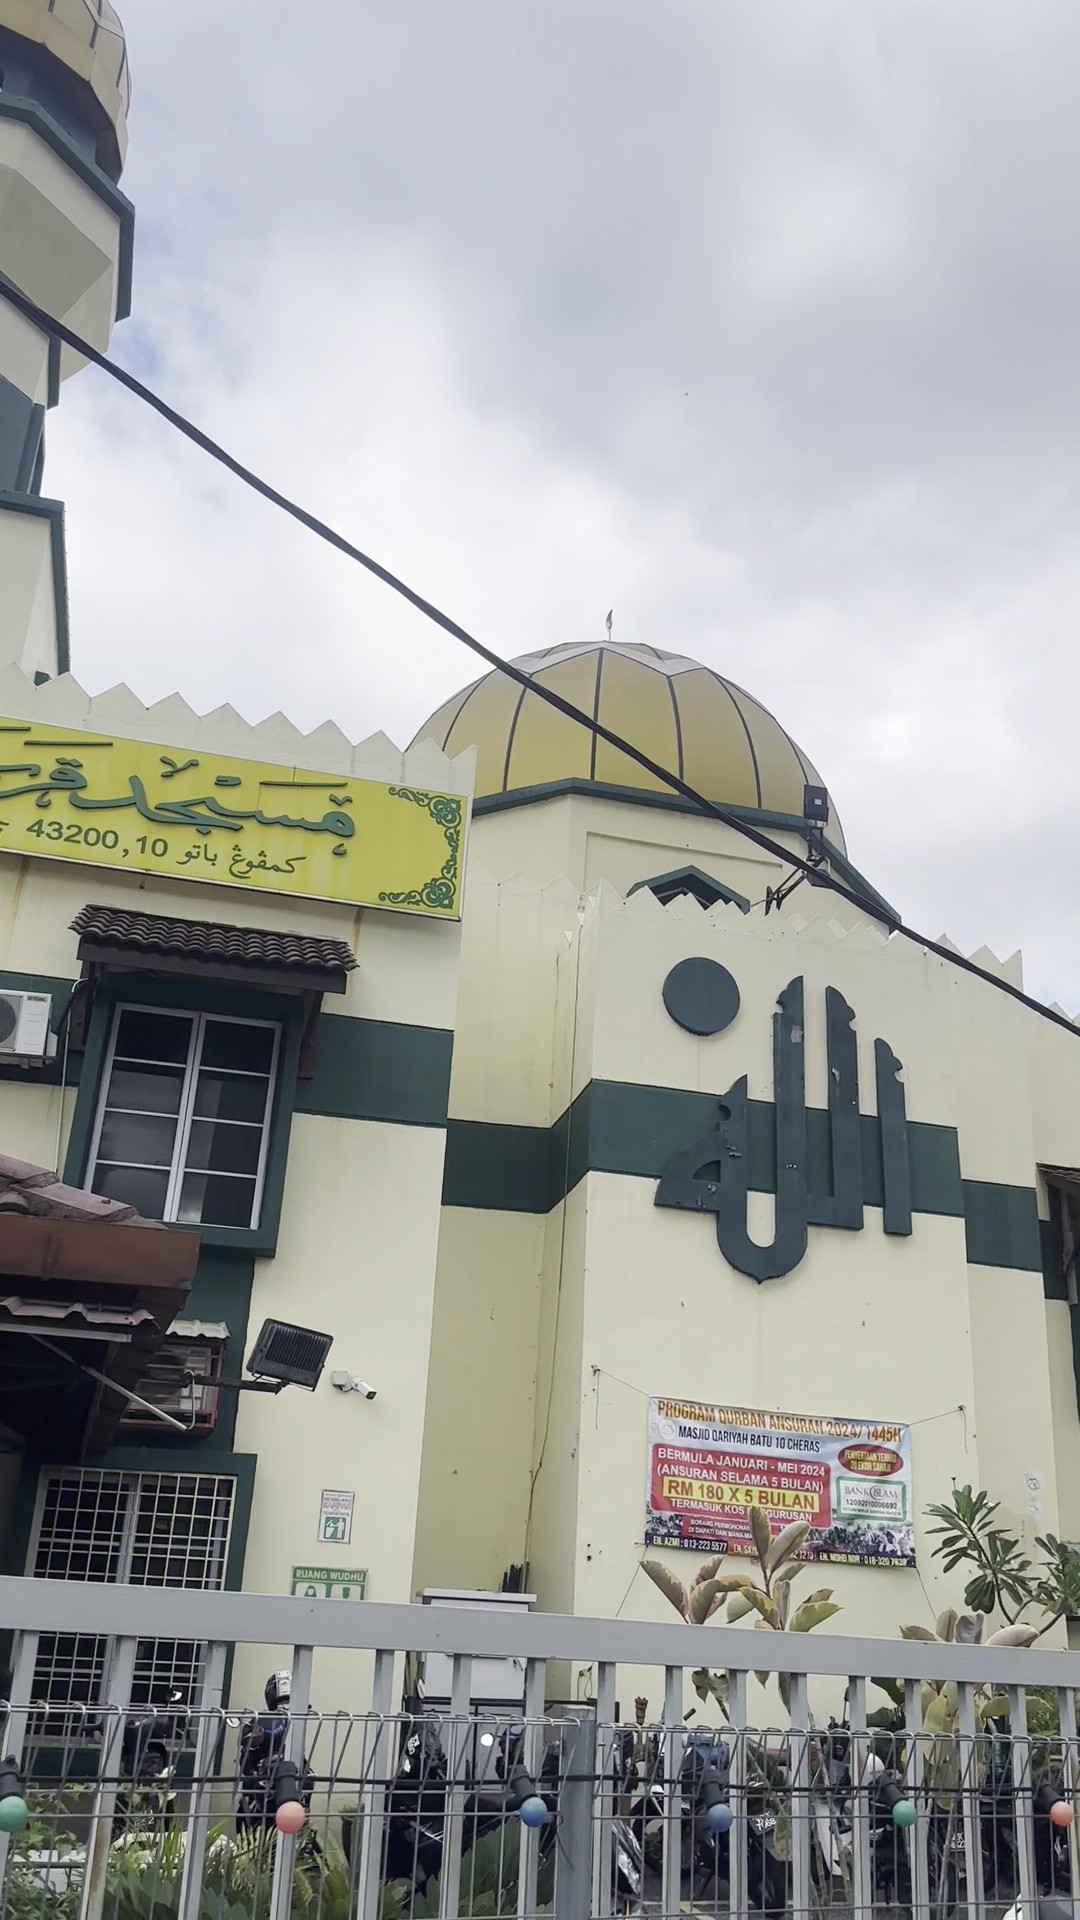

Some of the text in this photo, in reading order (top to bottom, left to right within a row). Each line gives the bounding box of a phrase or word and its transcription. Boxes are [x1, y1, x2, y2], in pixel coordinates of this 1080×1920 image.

[176, 843, 218, 865] باتو
[658, 1401, 716, 1423] PROGRAM
[719, 1409, 766, 1428] QURBAN
[769, 1414, 823, 1435] ANSURAN
[678, 1425, 820, 1453] MASJID QARIYAH BATU 10 CHERAS
[658, 1447, 714, 1465] BERMULA
[716, 1455, 768, 1471] JANUARI
[778, 1462, 798, 1474] MEI
[801, 1464, 826, 1478] 2024
[657, 1463, 824, 1495] (ANSURAN SELAMA 5 BULAN)
[668, 1479, 816, 1511] RM 180 X 5 BULAN
[845, 1485, 870, 1497] BANK
[671, 1498, 722, 1513] TERMASUK
[724, 1504, 745, 1516] KOS
[690, 1518, 714, 1527] BORANG
[664, 1536, 680, 1548] AZMI
[683, 1539, 710, 1550] 013-223
[711, 1541, 728, 1552] 5577
[848, 1554, 860, 1564] NOR
[295, 1569, 364, 1581] RUANG WUDHU
